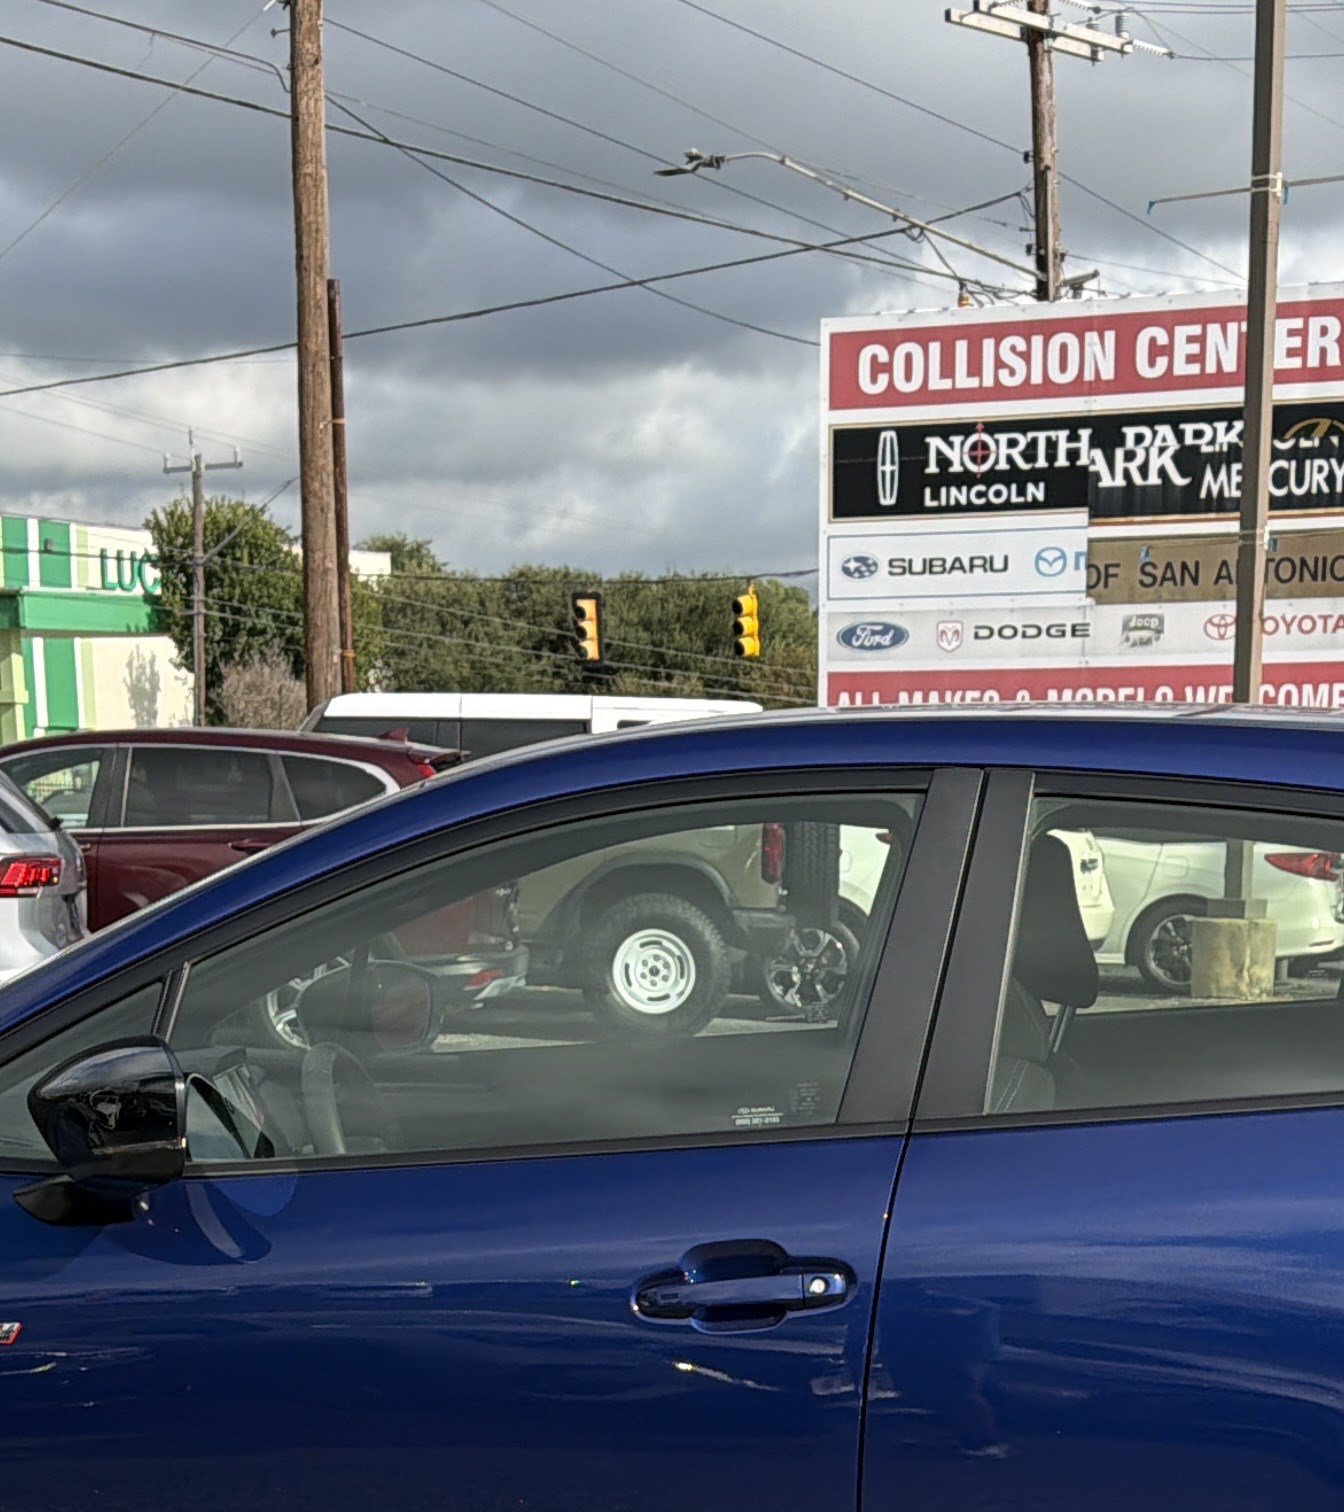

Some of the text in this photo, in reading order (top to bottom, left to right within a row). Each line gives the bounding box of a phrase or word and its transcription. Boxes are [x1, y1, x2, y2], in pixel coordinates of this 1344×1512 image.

[857, 315, 1343, 395] COLLISION CENER
[923, 427, 1094, 475] NORTH
[923, 481, 1046, 507] LINCOLN
[886, 553, 1010, 578] SUBARU
[1138, 559, 1201, 589] SAN
[851, 624, 894, 648] Ford
[972, 621, 1092, 641] DODGE
